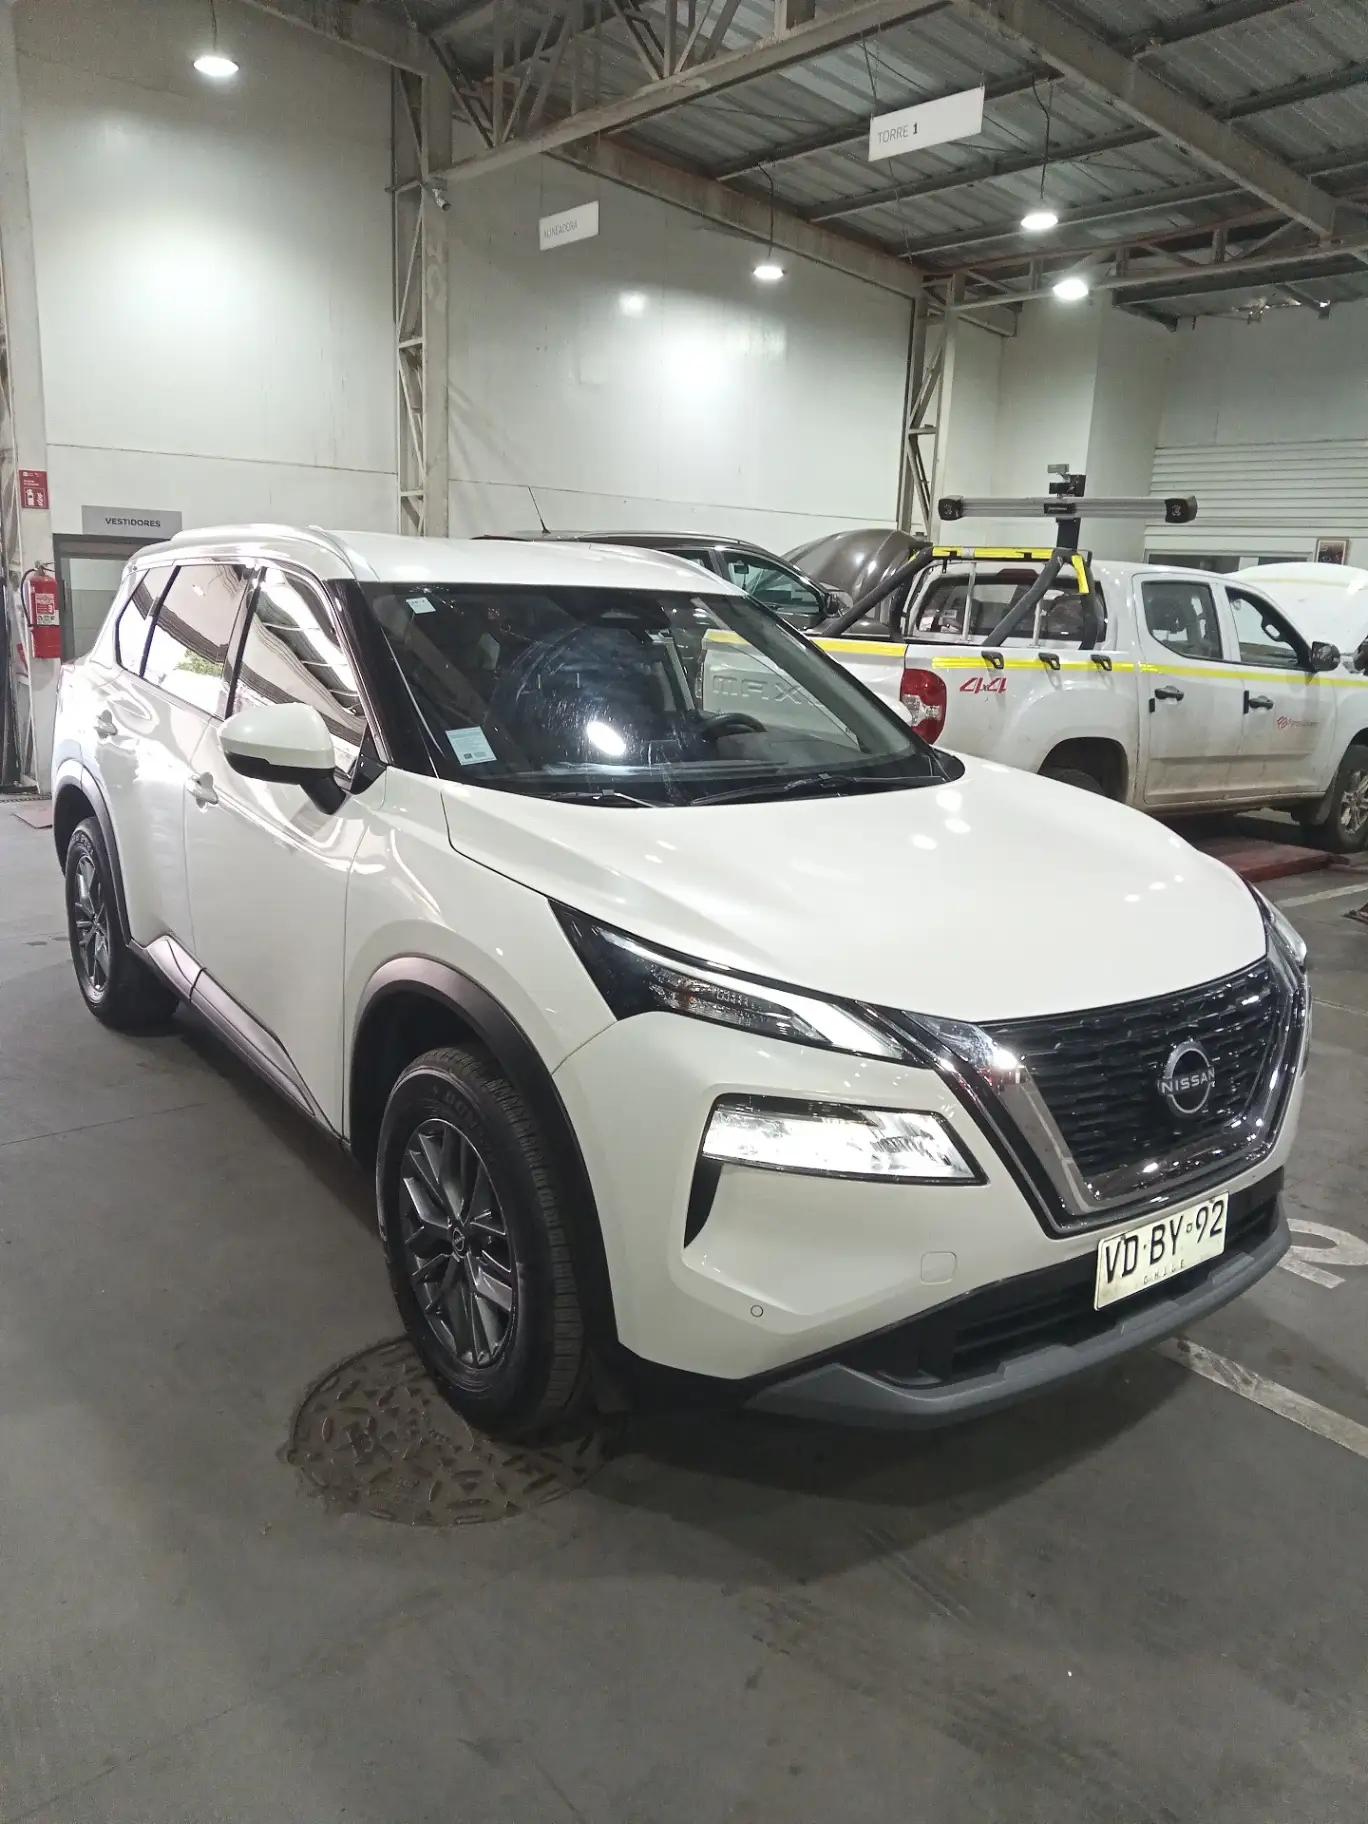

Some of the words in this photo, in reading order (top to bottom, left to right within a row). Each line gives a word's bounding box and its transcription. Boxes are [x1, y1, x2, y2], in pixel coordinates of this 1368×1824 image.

[878, 125, 908, 143] TORRE
[913, 122, 918, 135] 1
[105, 517, 161, 528] VESTIDORES
[959, 677, 1007, 694] 4x4
[1161, 1067, 1215, 1094] NISSAN
